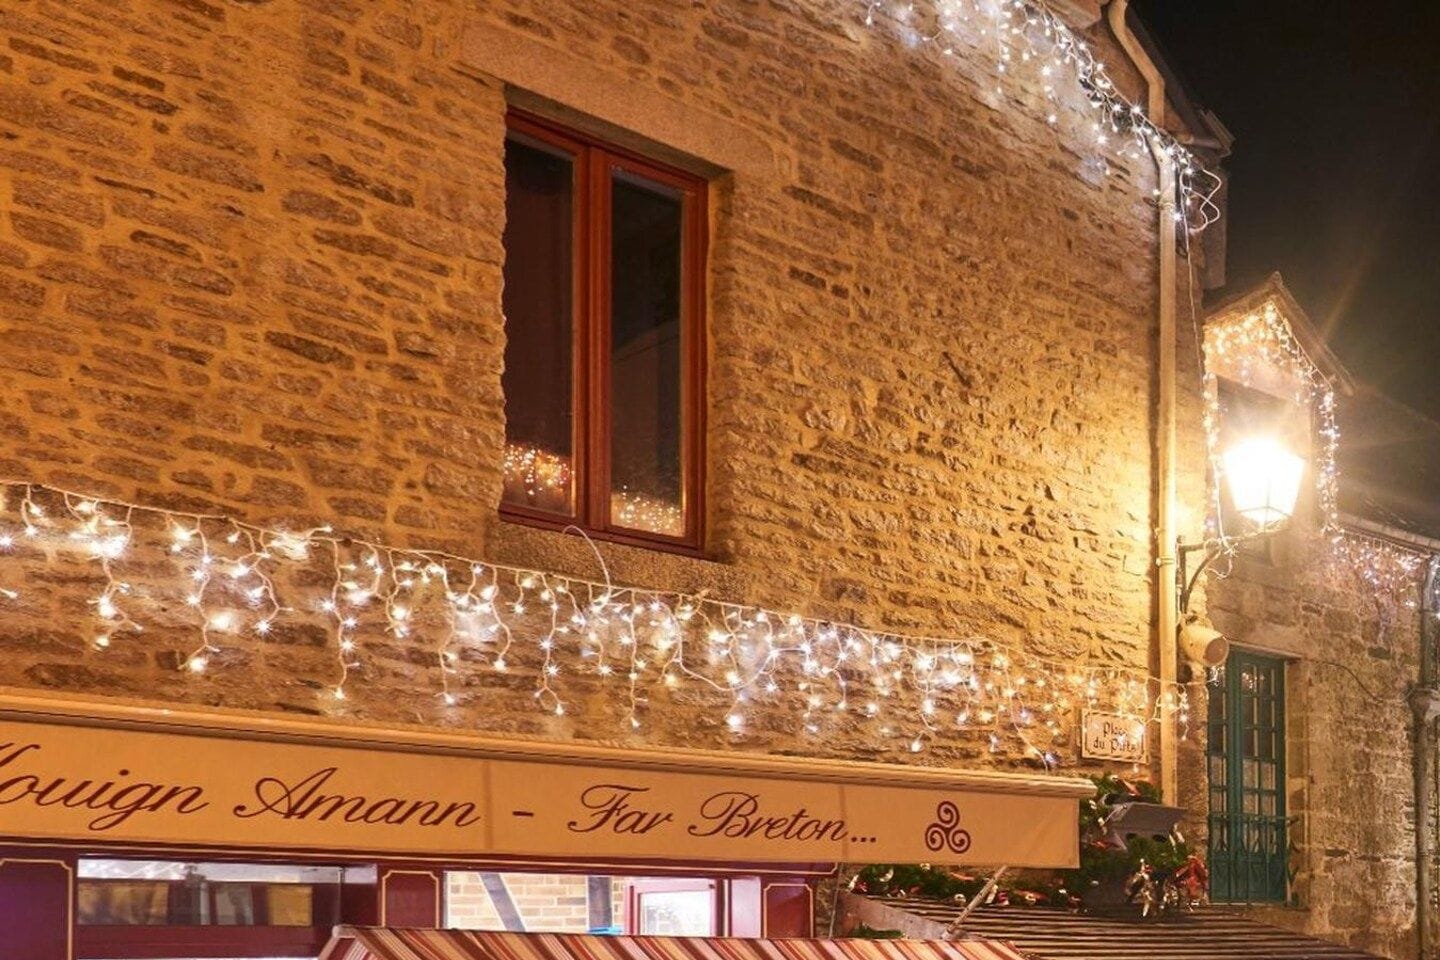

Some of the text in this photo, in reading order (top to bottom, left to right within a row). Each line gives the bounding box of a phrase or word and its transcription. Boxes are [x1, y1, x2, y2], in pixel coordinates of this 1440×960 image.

[1093, 736, 1106, 750] du
[230, 767, 481, 828] Amann
[567, 784, 674, 834] Far
